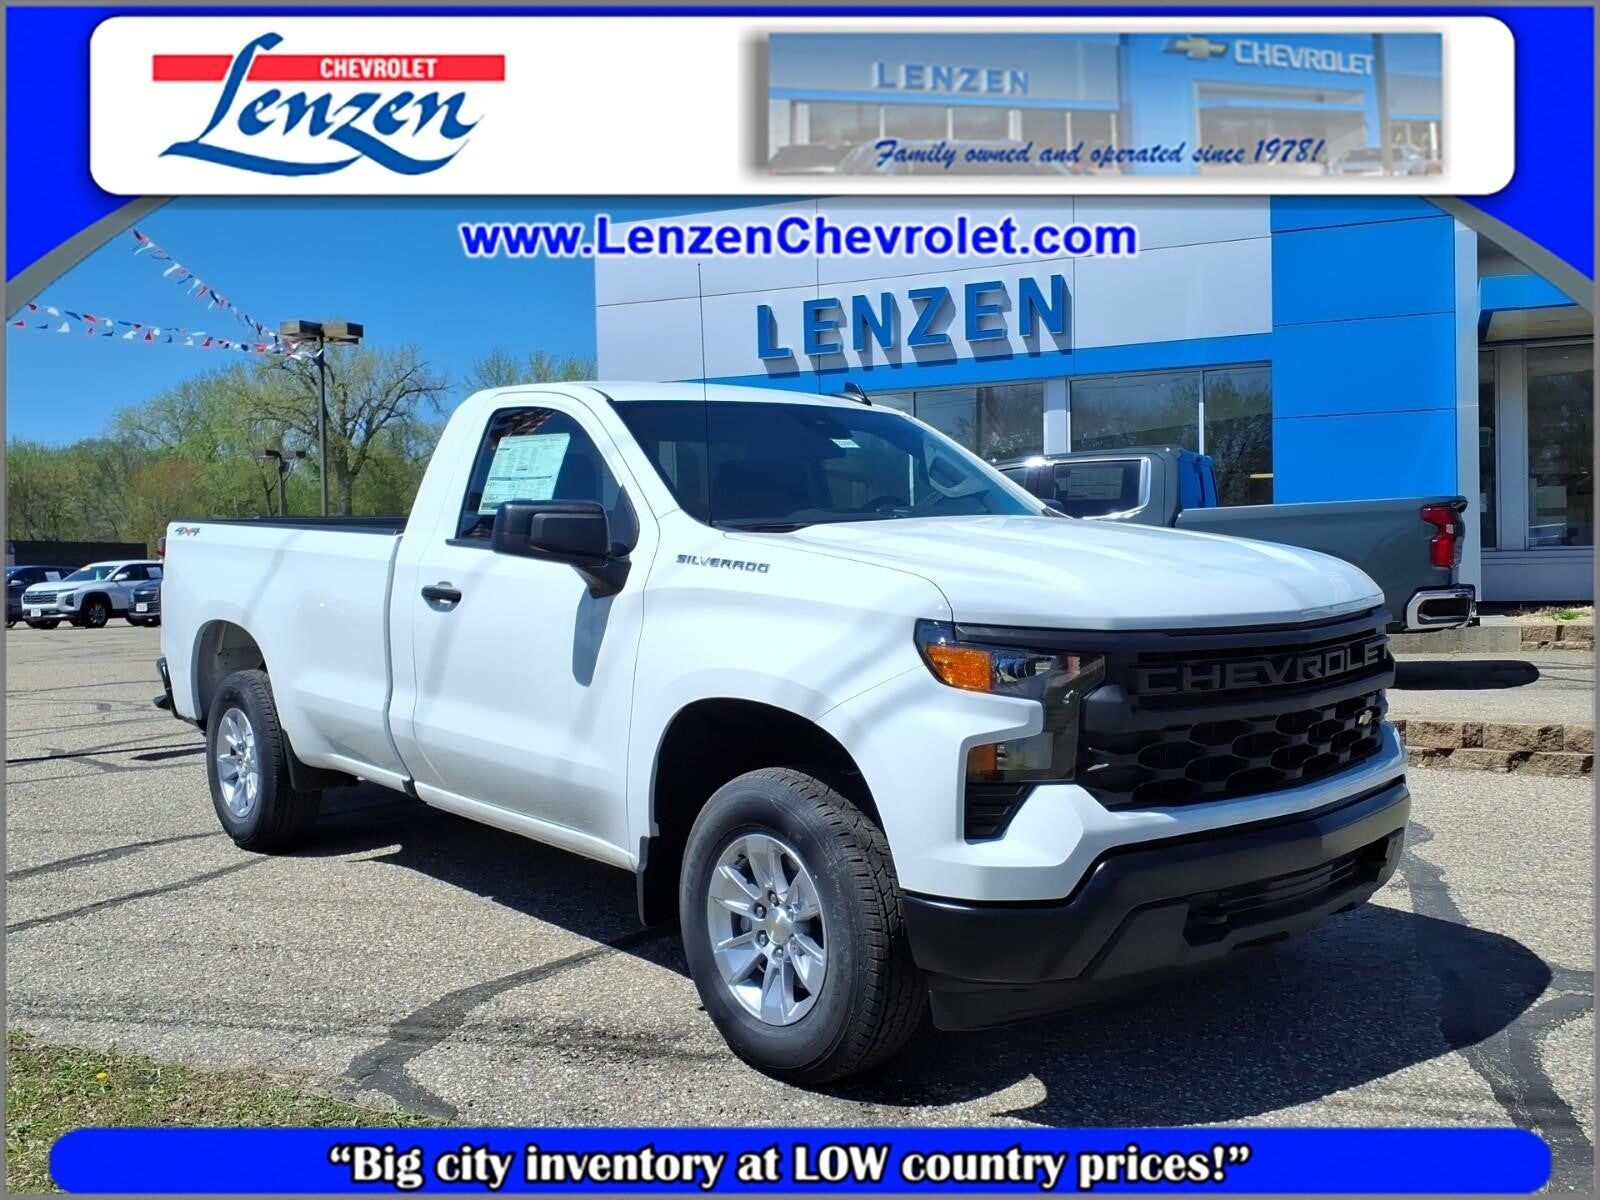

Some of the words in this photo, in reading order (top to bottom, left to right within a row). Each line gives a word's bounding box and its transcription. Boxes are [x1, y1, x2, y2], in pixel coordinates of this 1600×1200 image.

[756, 274, 1068, 360] LENZEN
[676, 553, 770, 574] SILVERADO
[1138, 637, 1390, 694] CHEVROLET
